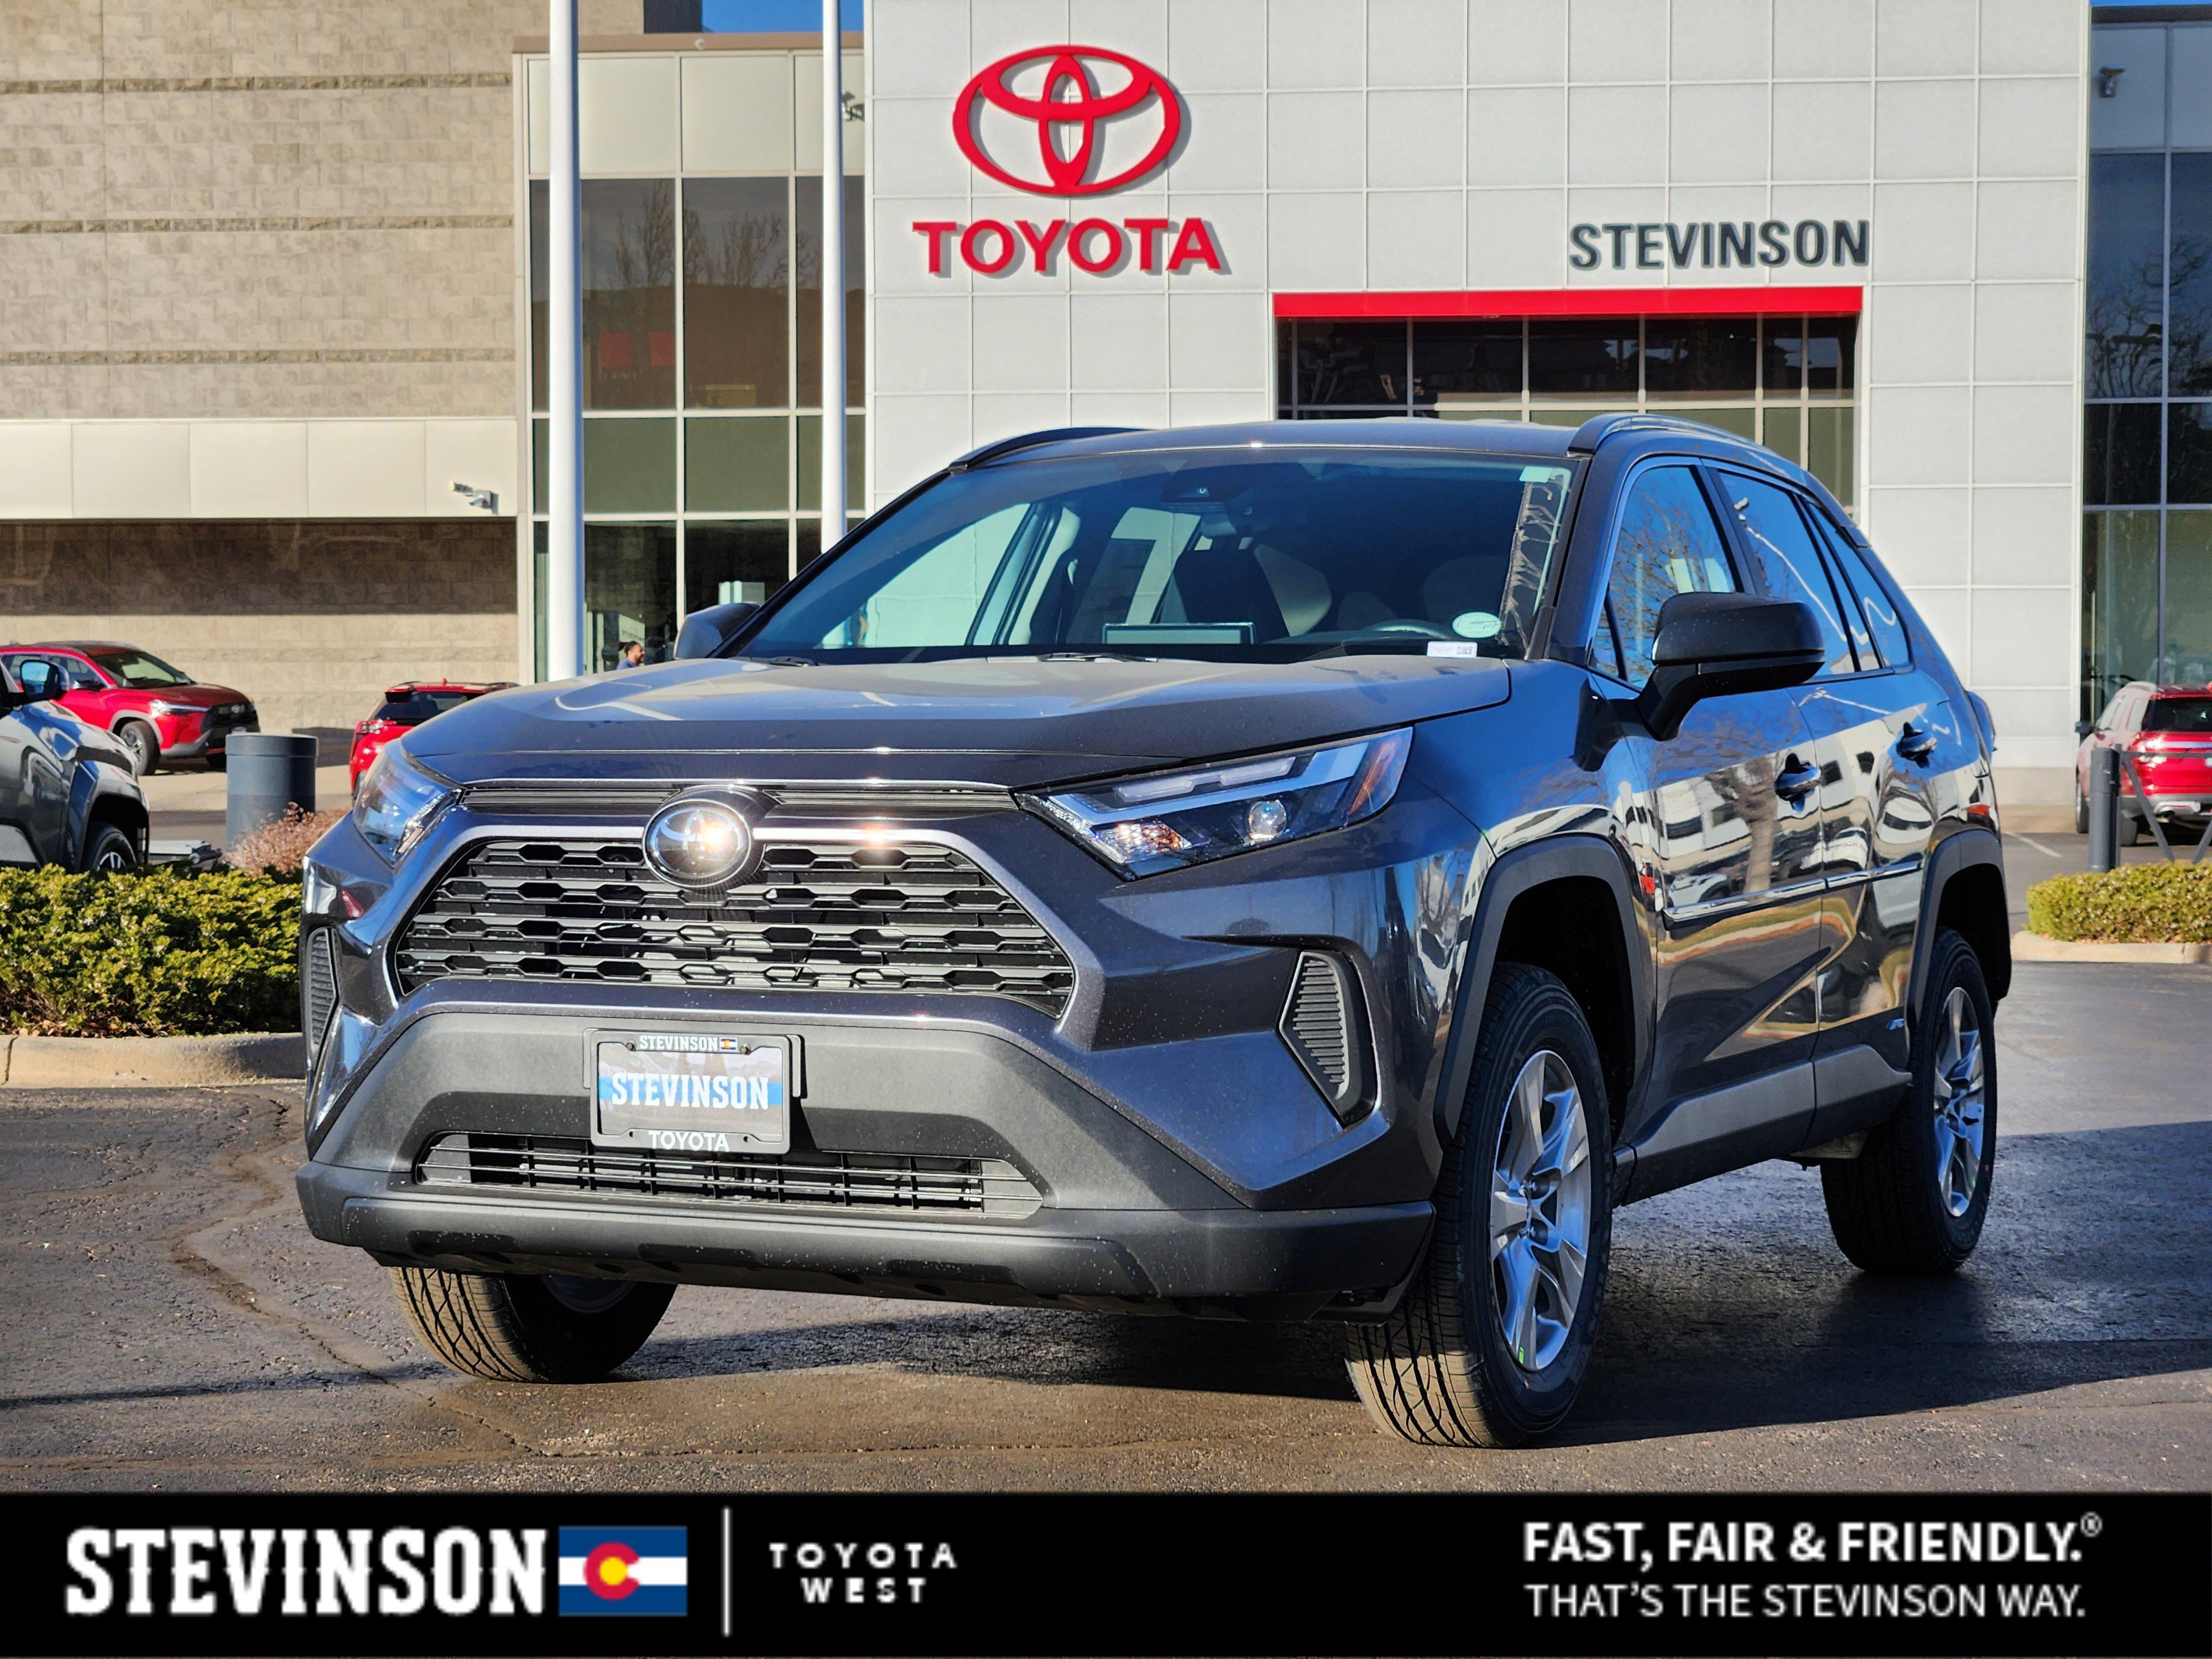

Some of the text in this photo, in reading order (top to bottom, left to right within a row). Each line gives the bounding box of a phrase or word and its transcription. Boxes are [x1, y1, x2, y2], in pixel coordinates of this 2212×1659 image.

[912, 217, 1222, 275] TOYOTA
[1569, 219, 1869, 270] STEVINSON
[639, 1035, 718, 1052] STEVINSON
[611, 1072, 769, 1110] STEVINSON
[648, 1130, 731, 1152] TOYOTA
